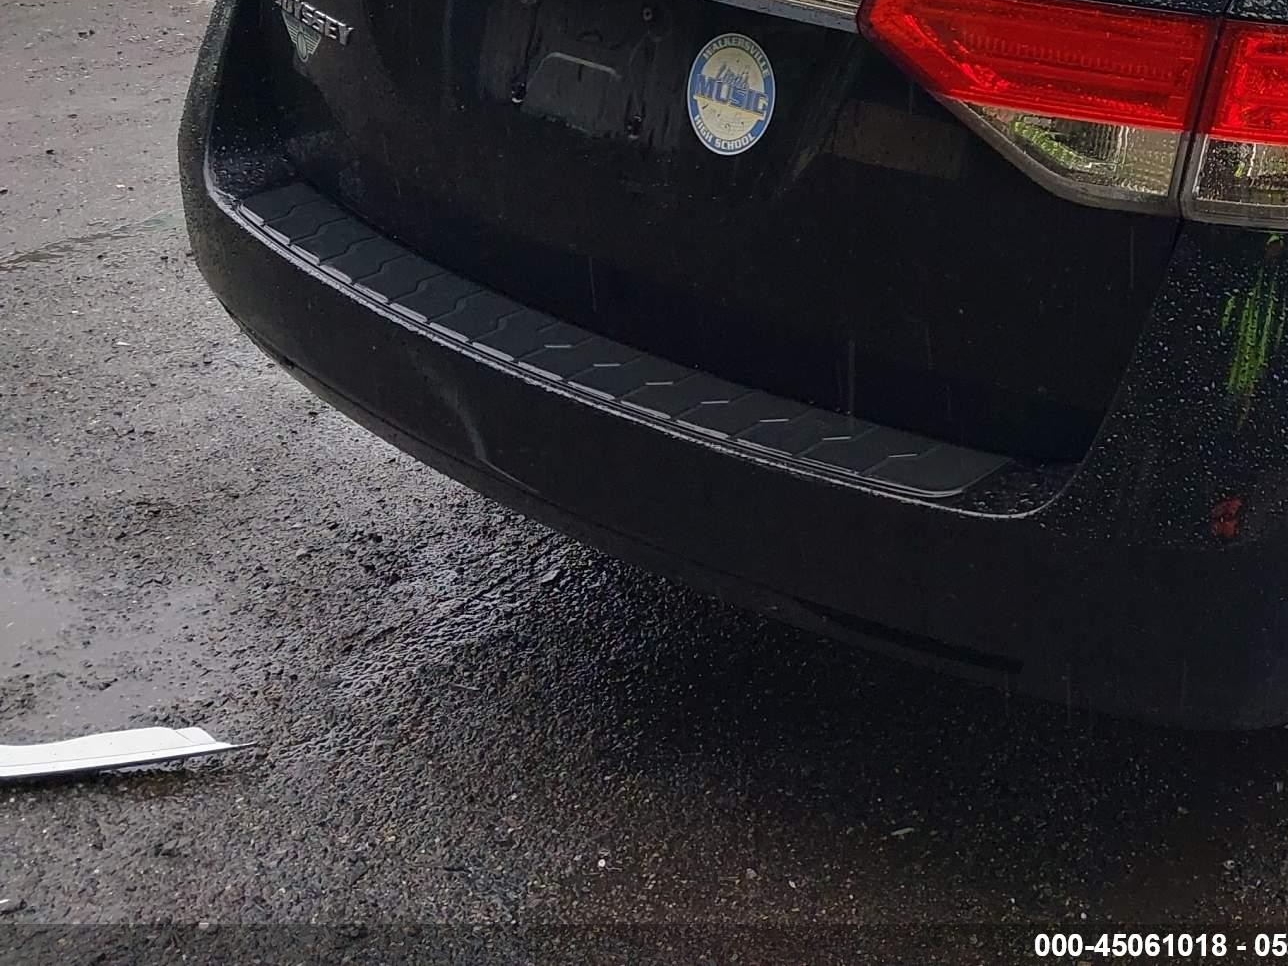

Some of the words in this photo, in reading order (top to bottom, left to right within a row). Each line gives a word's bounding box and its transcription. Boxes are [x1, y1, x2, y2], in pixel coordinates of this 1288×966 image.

[702, 36, 770, 79] WALKERSVILLE
[694, 73, 769, 116] MUSIC
[694, 115, 714, 143] HIGH
[714, 132, 756, 151] SCHOOL
